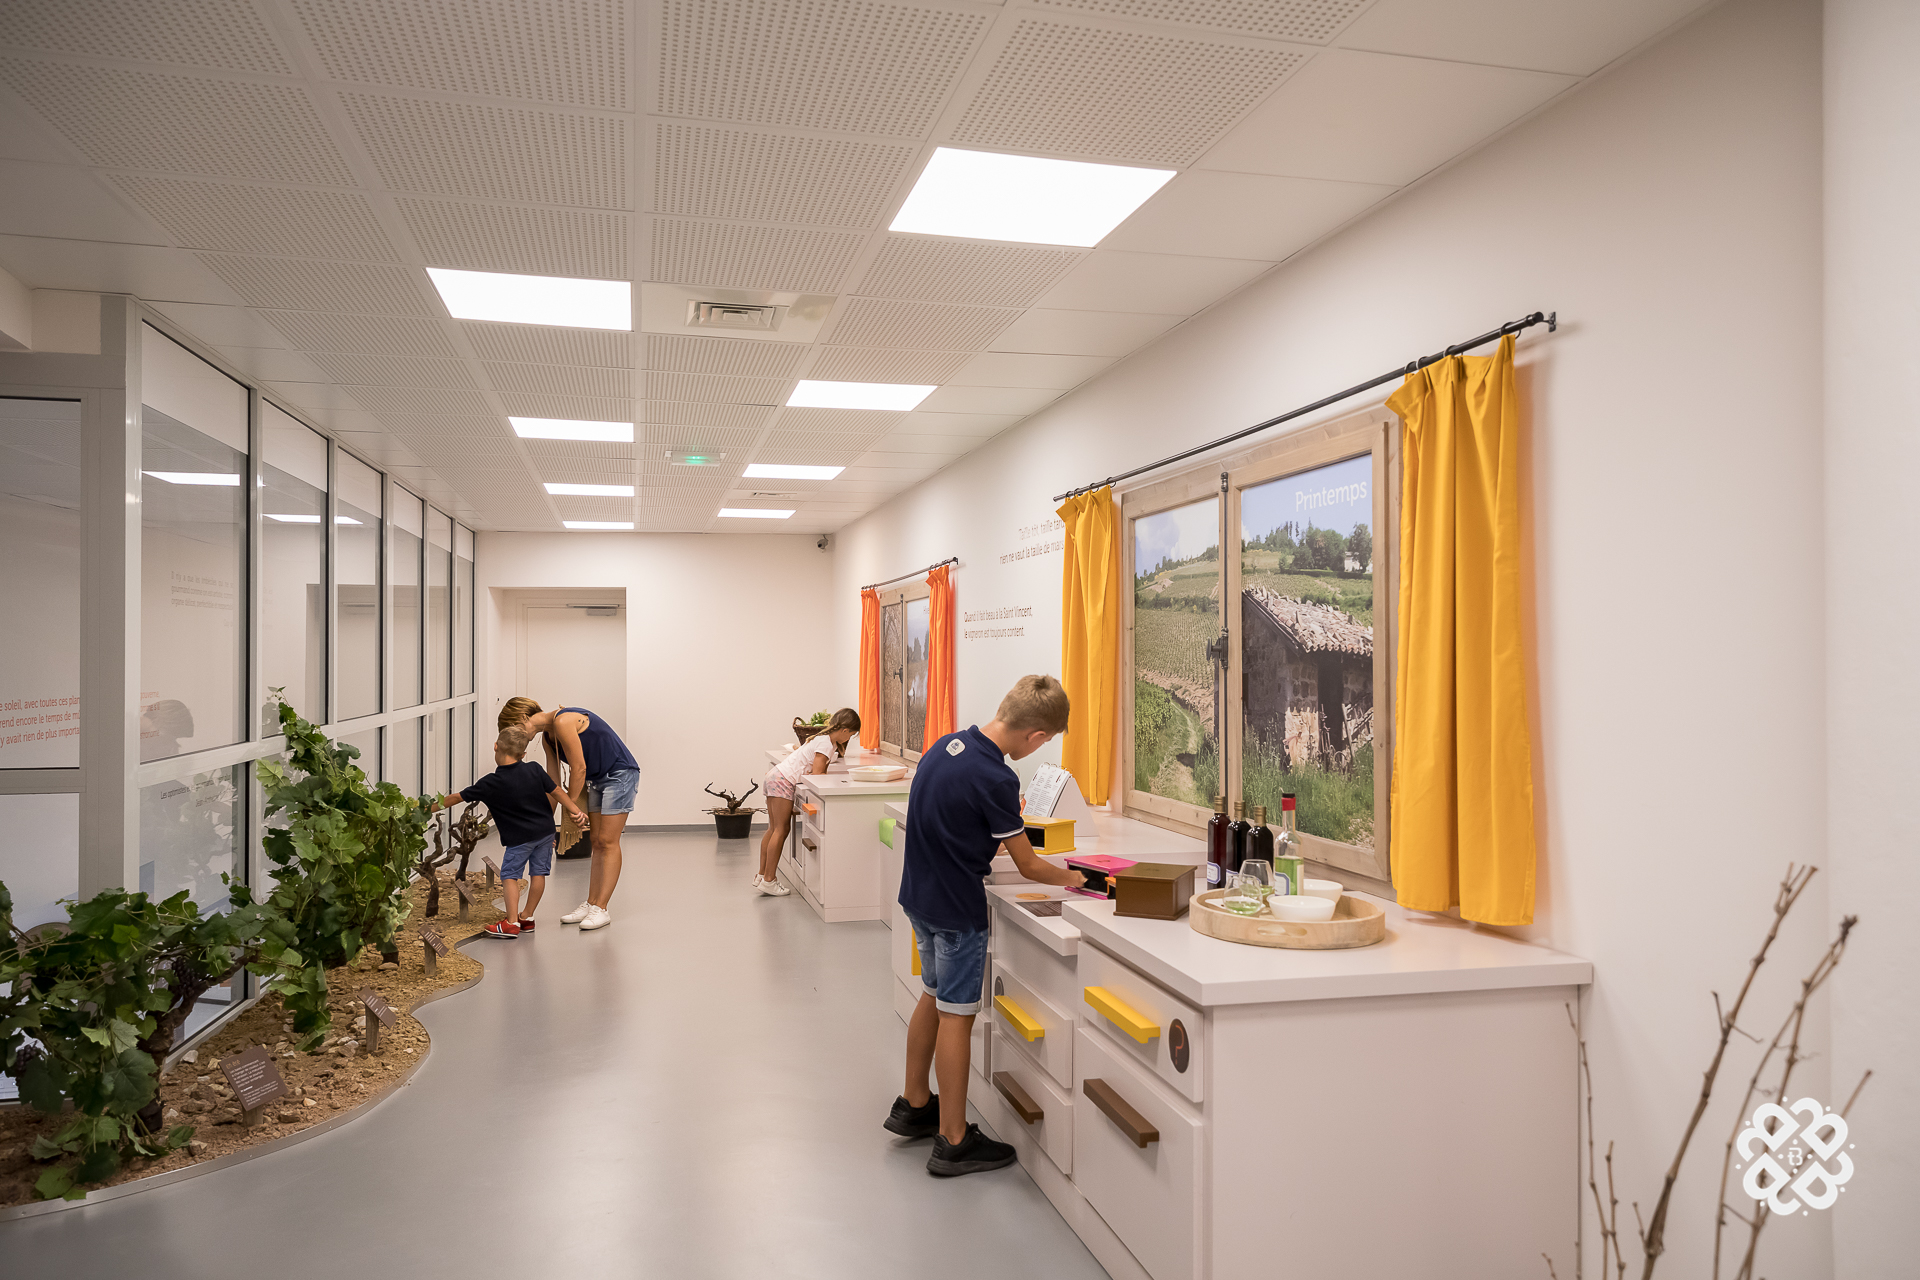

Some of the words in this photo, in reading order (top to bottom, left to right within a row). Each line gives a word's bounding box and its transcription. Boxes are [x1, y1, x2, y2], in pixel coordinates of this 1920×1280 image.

[1296, 481, 1367, 512] Printemps
[1015, 548, 1024, 560] vaut
[1044, 541, 1050, 553] de
[964, 610, 976, 622] Quand
[986, 610, 995, 620] beau
[1003, 607, 1013, 618] Saint
[968, 628, 983, 641] vigneron
[990, 626, 1006, 640] toujours
[4, 699, 22, 711] soleil,
[24, 700, 38, 709] avec
[39, 698, 57, 708] toutes
[58, 698, 68, 706] ces
[68, 695, 80, 707] plan
[0, 716, 14, 728] rend
[16, 716, 37, 726] encore
[39, 714, 44, 724] le
[45, 713, 63, 724] temps
[64, 711, 71, 721] de
[6, 732, 21, 745] avait
[23, 731, 35, 742] rien
[37, 729, 44, 740] de
[45, 728, 57, 741] plus
[58, 726, 80, 738] importa
